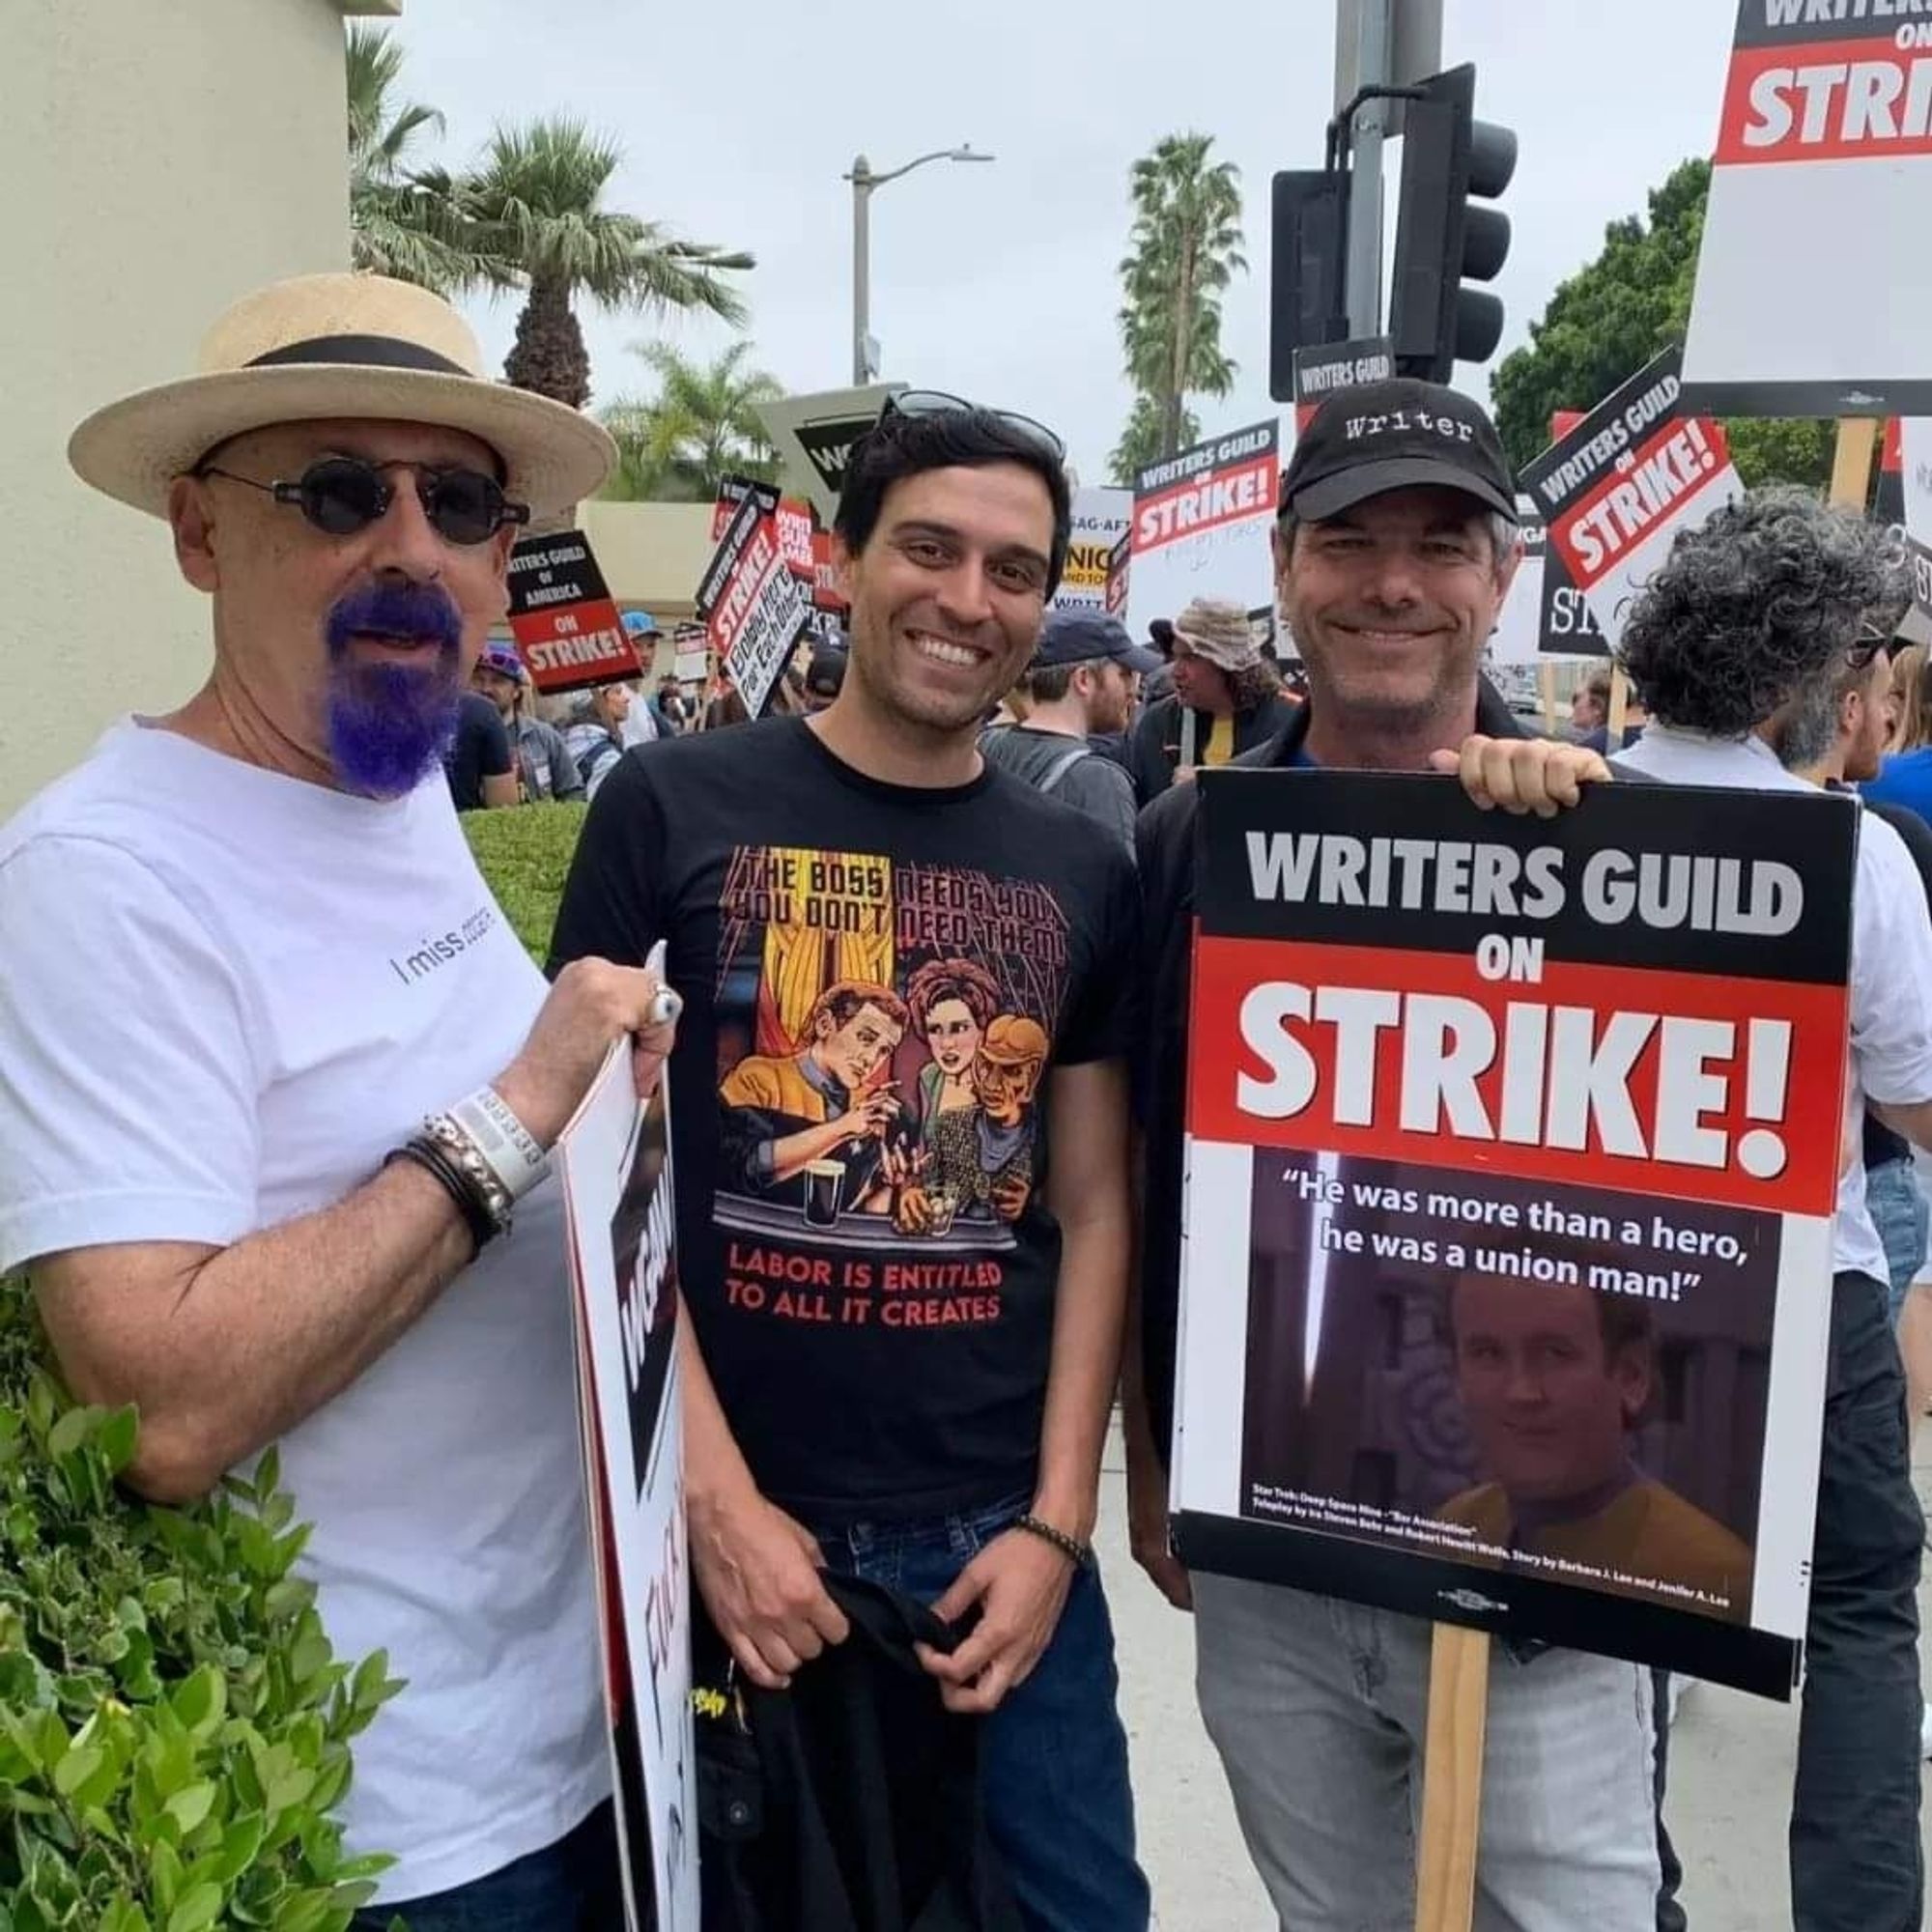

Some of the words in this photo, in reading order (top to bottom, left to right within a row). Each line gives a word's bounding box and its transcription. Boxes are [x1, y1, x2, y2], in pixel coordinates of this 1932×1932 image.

[1301, 360, 1354, 393] WRITERS
[1355, 355, 1390, 384] GUILD
[1345, 411, 1474, 442] writer
[1540, 417, 1630, 504] WRITERS
[1625, 374, 1681, 433] GUILD
[1142, 446, 1215, 490] WRITERS
[1218, 429, 1271, 461] GUILD
[1614, 447, 1636, 473] ON
[1138, 468, 1268, 545] STRIKE!
[1569, 417, 1717, 575] STRIKE!
[548, 546, 586, 565] GUILD
[526, 582, 582, 608] AMERICA
[716, 528, 773, 645] STRIKE!
[526, 627, 628, 671] STRIKE!
[554, 614, 579, 633] ON
[745, 855, 796, 890] THE
[810, 860, 884, 897] BOSS
[895, 869, 983, 912] NEEDS
[1246, 831, 1566, 920] WRITERS
[1582, 848, 1804, 937] GUILD
[732, 891, 791, 924] YOU
[806, 896, 886, 935] DON'T
[899, 906, 969, 947] NEED
[407, 932, 465, 978] miss
[1477, 934, 1543, 982] ON
[1236, 981, 1792, 1179] STRIKE!
[1352, 1184, 1418, 1213] was
[1427, 1196, 1519, 1228] more
[1528, 1203, 1611, 1240] than
[1620, 1222, 1642, 1246] a
[1652, 1216, 1748, 1267] hero,
[728, 1243, 833, 1286] LABOR
[843, 1263, 872, 1289] IS
[882, 1261, 1003, 1291] ENTITLED
[1321, 1219, 1364, 1253] he
[1372, 1234, 1437, 1264] was
[1446, 1245, 1466, 1269] a
[1475, 1245, 1578, 1287] union
[726, 1279, 766, 1309] TO
[773, 1291, 832, 1321] ALL
[842, 1297, 873, 1323] IT
[881, 1295, 1001, 1326] CREATES
